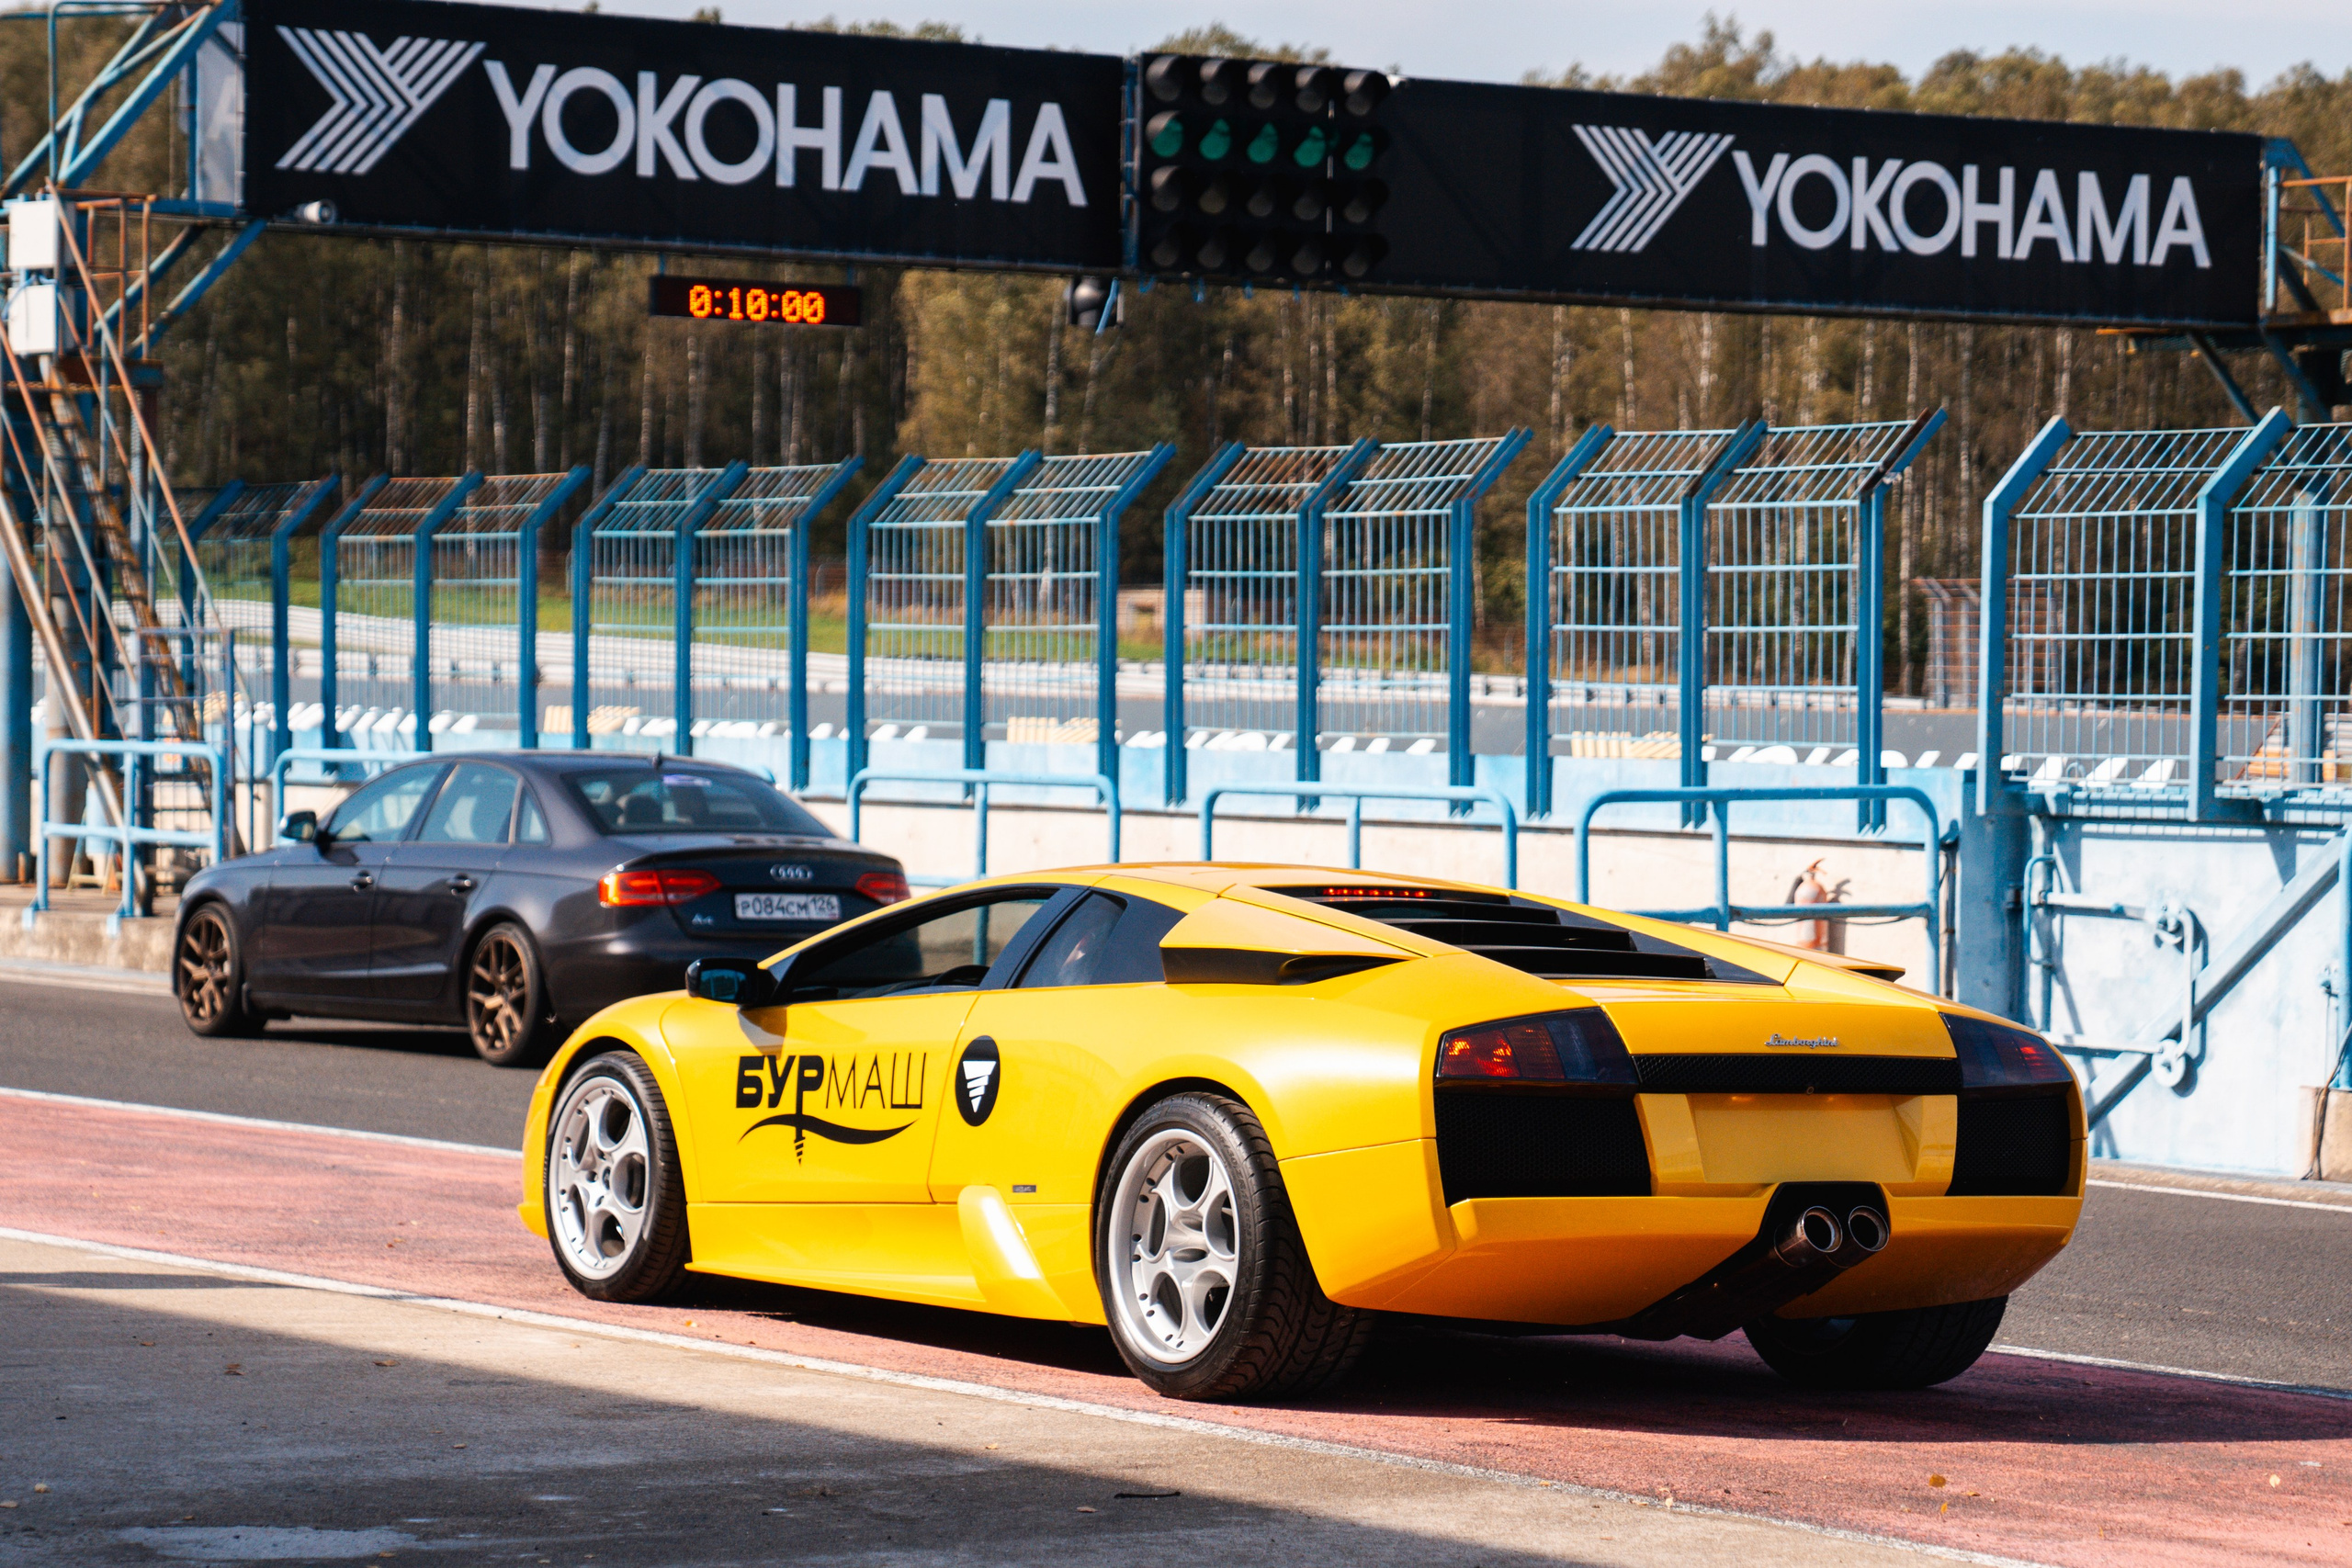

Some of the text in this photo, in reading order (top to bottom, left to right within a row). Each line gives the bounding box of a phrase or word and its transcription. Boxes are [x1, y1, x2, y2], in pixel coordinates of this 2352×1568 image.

[483, 60, 1088, 208] YOKOHAMA
[1733, 151, 2212, 269] YOKOHAMA
[690, 285, 825, 324] 0:10:00
[1764, 1033, 1839, 1049] Lamborghini
[736, 1052, 927, 1110] БУРМАШ
